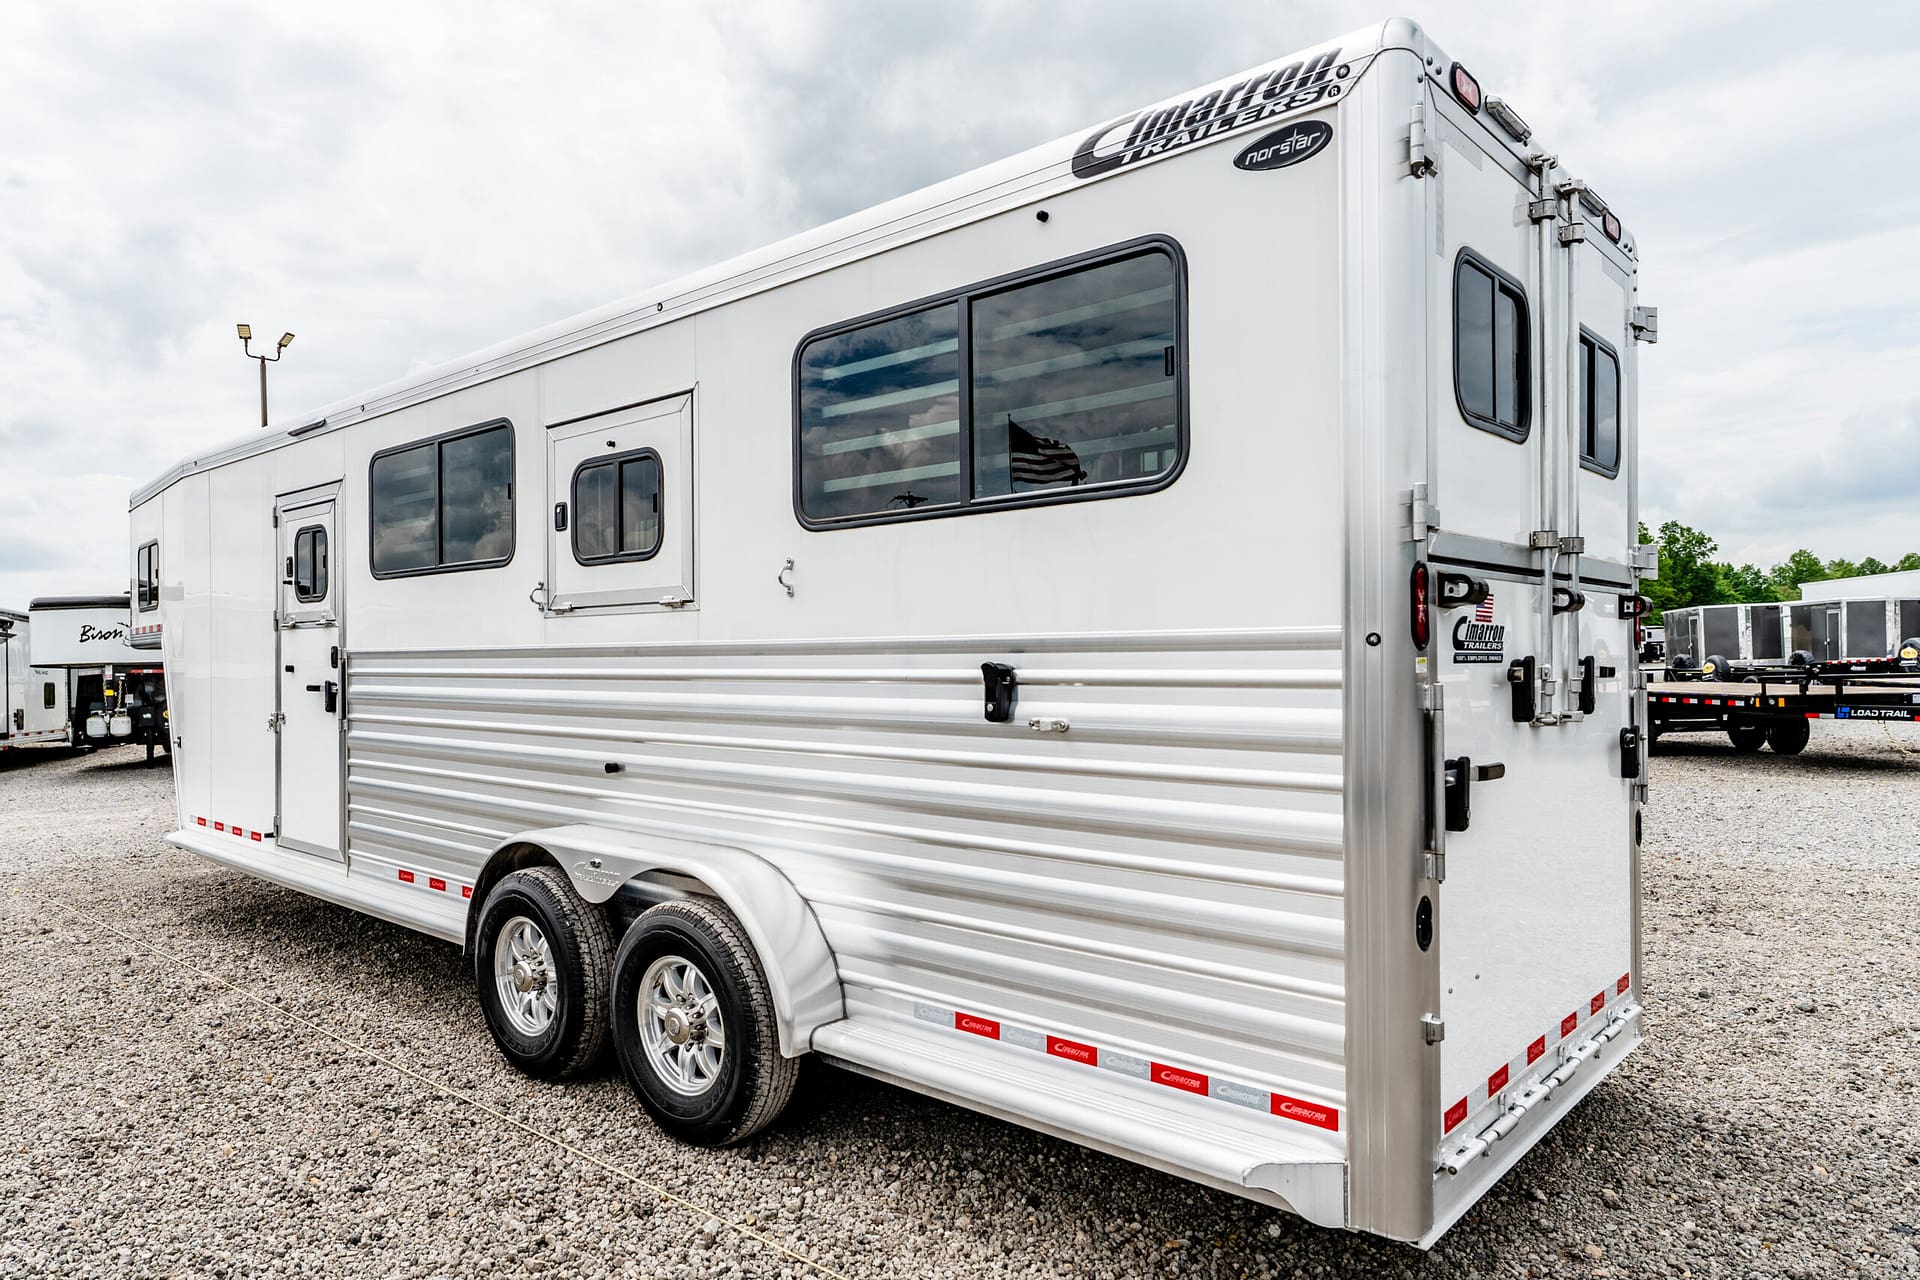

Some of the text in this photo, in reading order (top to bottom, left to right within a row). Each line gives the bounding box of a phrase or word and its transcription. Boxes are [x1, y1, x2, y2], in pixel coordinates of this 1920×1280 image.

[1071, 48, 1342, 179] Cimarron
[1120, 86, 1322, 165] TRAILERS
[1245, 128, 1321, 165] norstar
[79, 624, 123, 643] Bison
[1453, 616, 1504, 651] Cimarron
[1464, 641, 1502, 650] TRAILERS
[1851, 709, 1879, 717] LOAD
[1880, 710, 1911, 718] TRAIL
